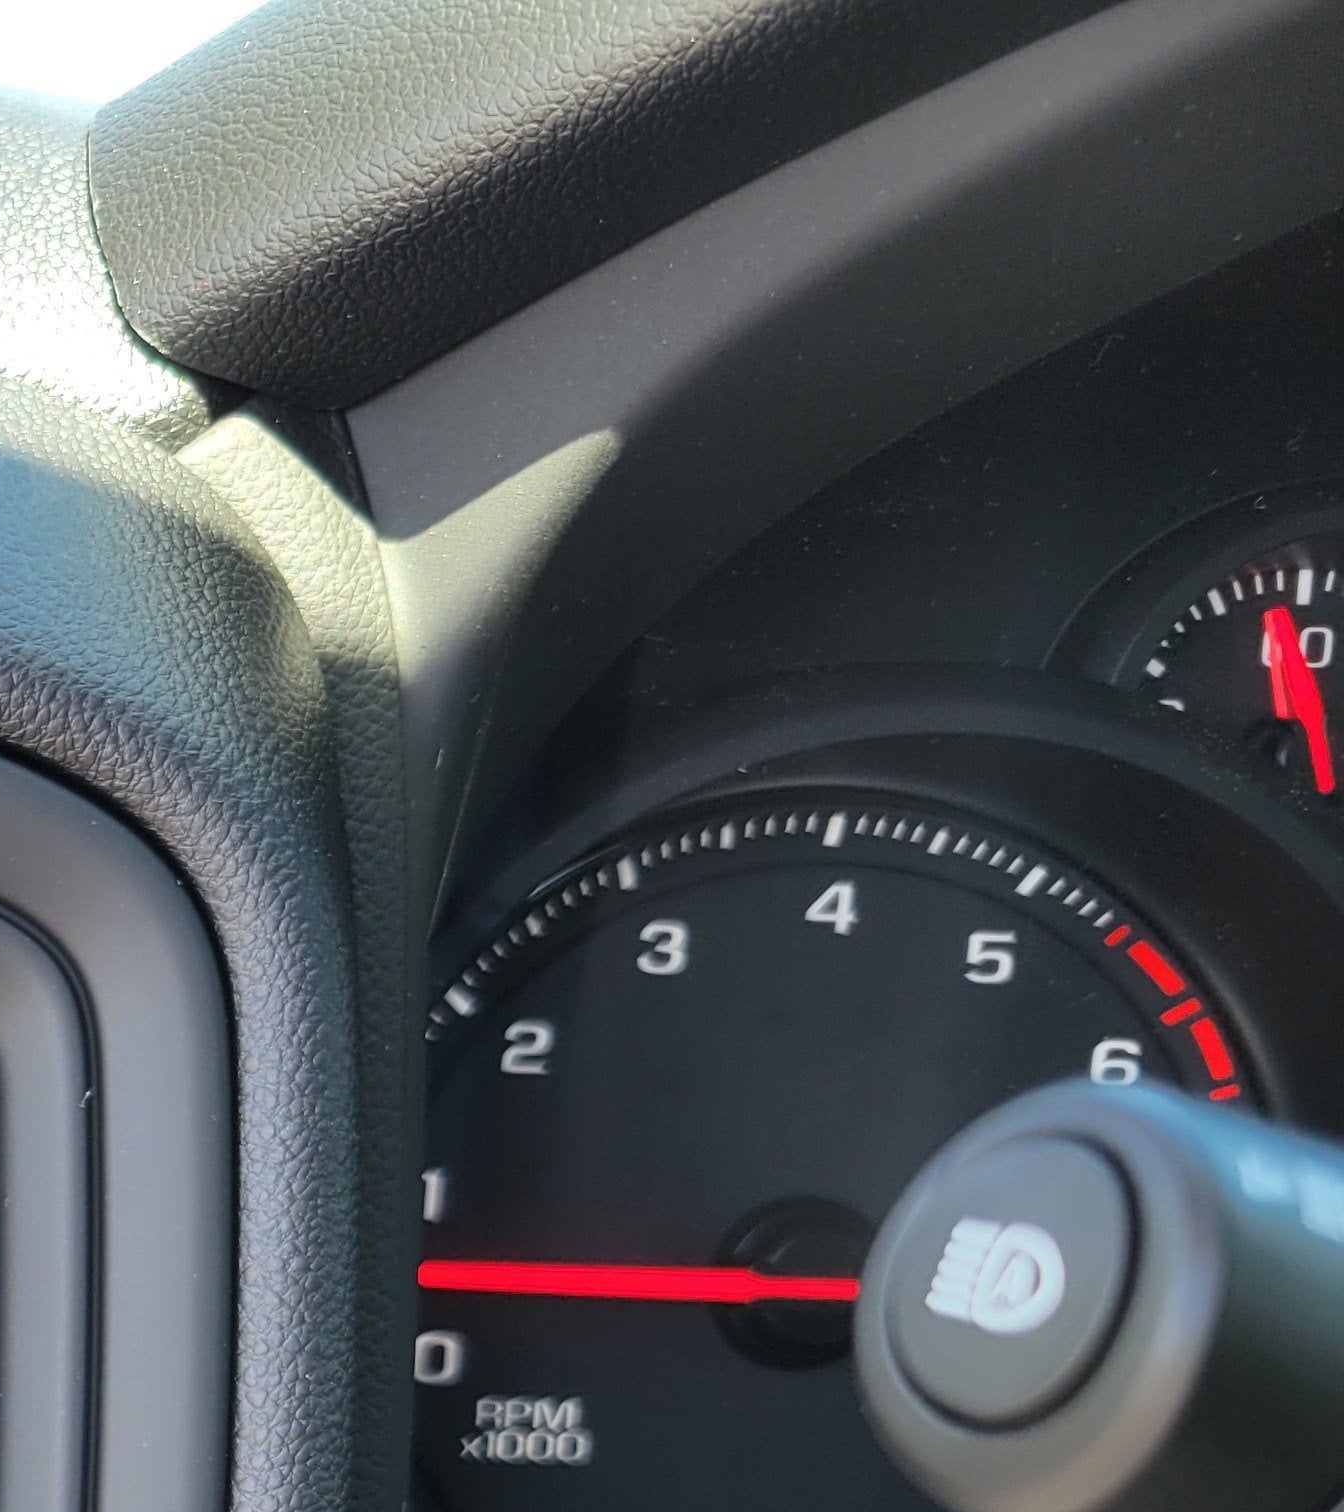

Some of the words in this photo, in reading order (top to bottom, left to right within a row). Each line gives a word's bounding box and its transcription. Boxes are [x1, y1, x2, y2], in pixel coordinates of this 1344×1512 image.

[805, 880, 858, 936] 4
[636, 918, 690, 976] 3
[963, 930, 1018, 984] 5
[500, 1018, 557, 1075] 2
[1090, 1037, 1143, 1086] 6
[421, 1167, 448, 1224] 1
[414, 1330, 466, 1386] 0
[475, 1397, 584, 1431] RPM
